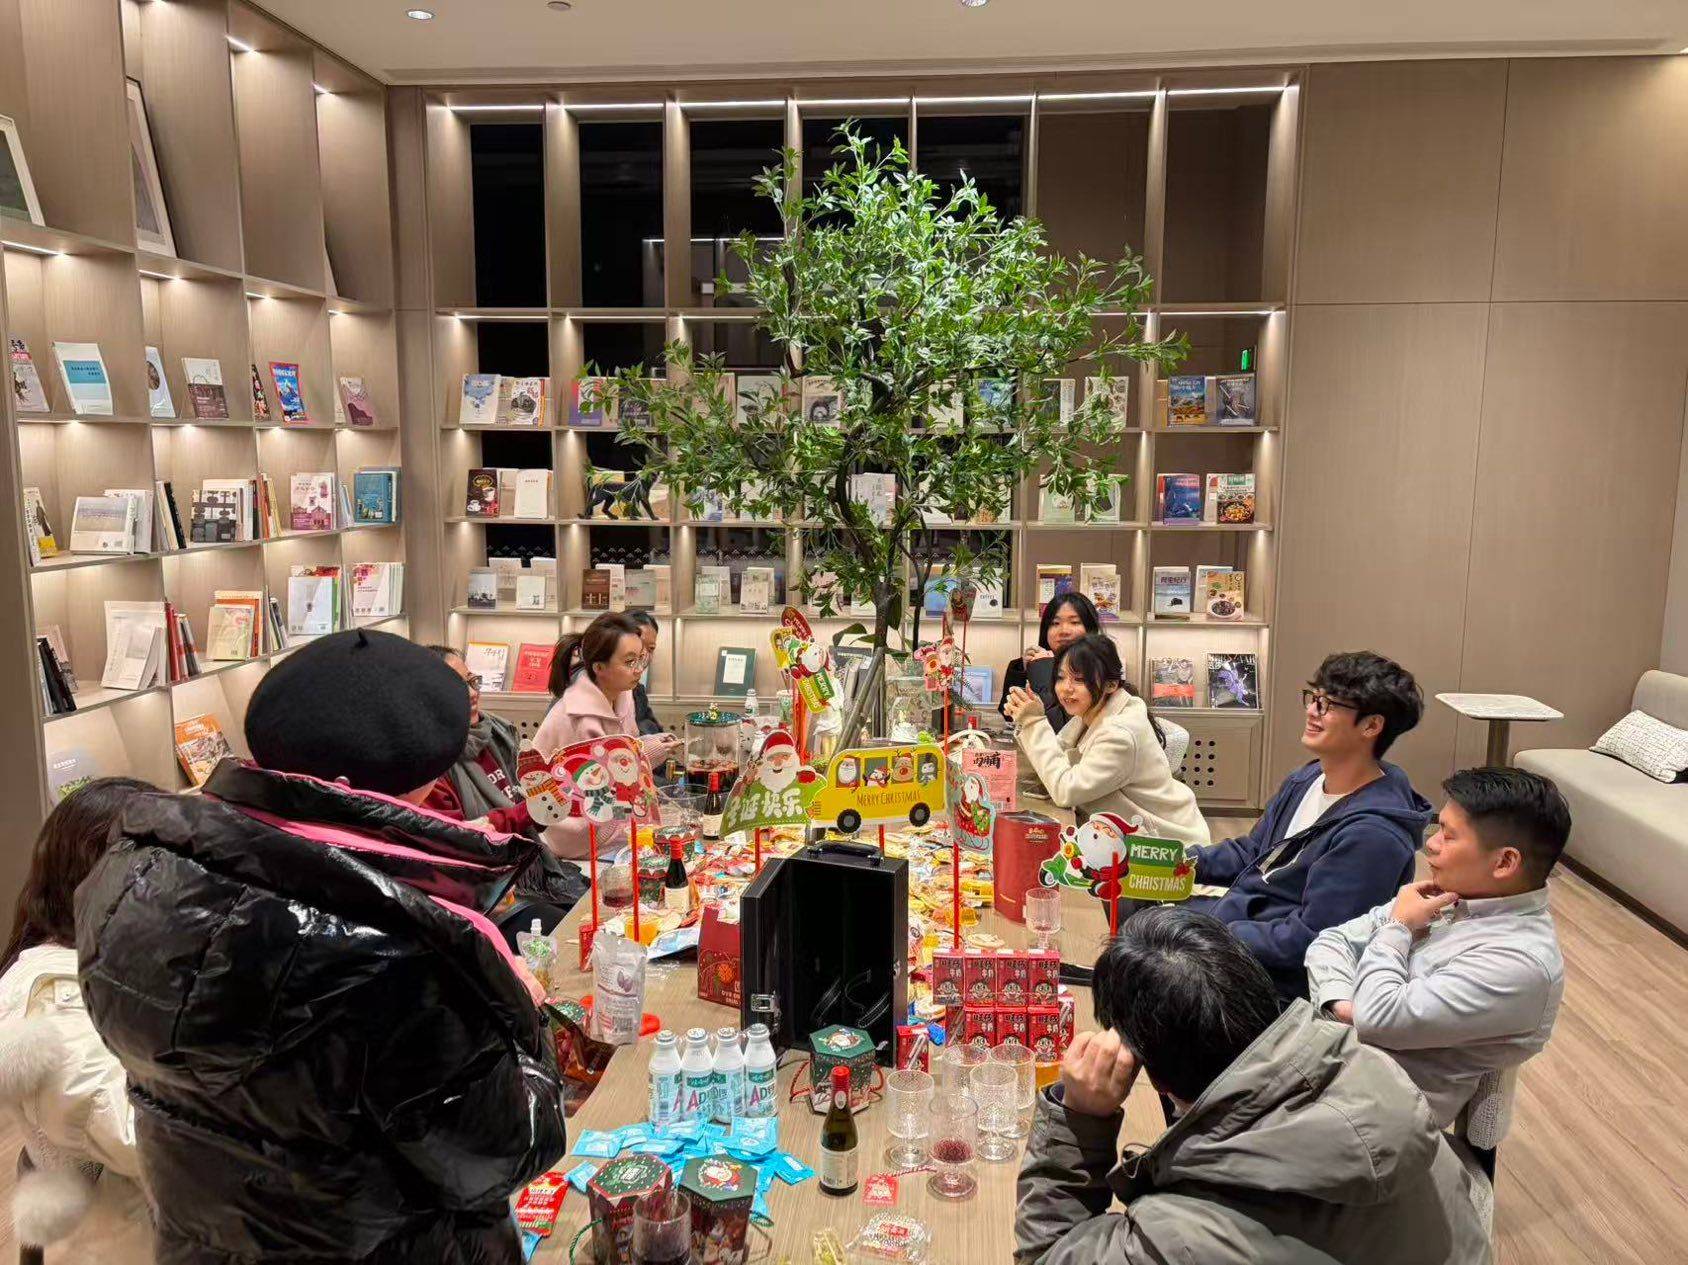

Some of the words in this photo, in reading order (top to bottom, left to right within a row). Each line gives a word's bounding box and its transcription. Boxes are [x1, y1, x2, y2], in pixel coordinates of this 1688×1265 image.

[857, 793, 879, 808] MERRY
[880, 789, 920, 805] CHRISTMAS
[1130, 843, 1178, 861] MERRY
[1129, 873, 1187, 892] CHRISTMAS
